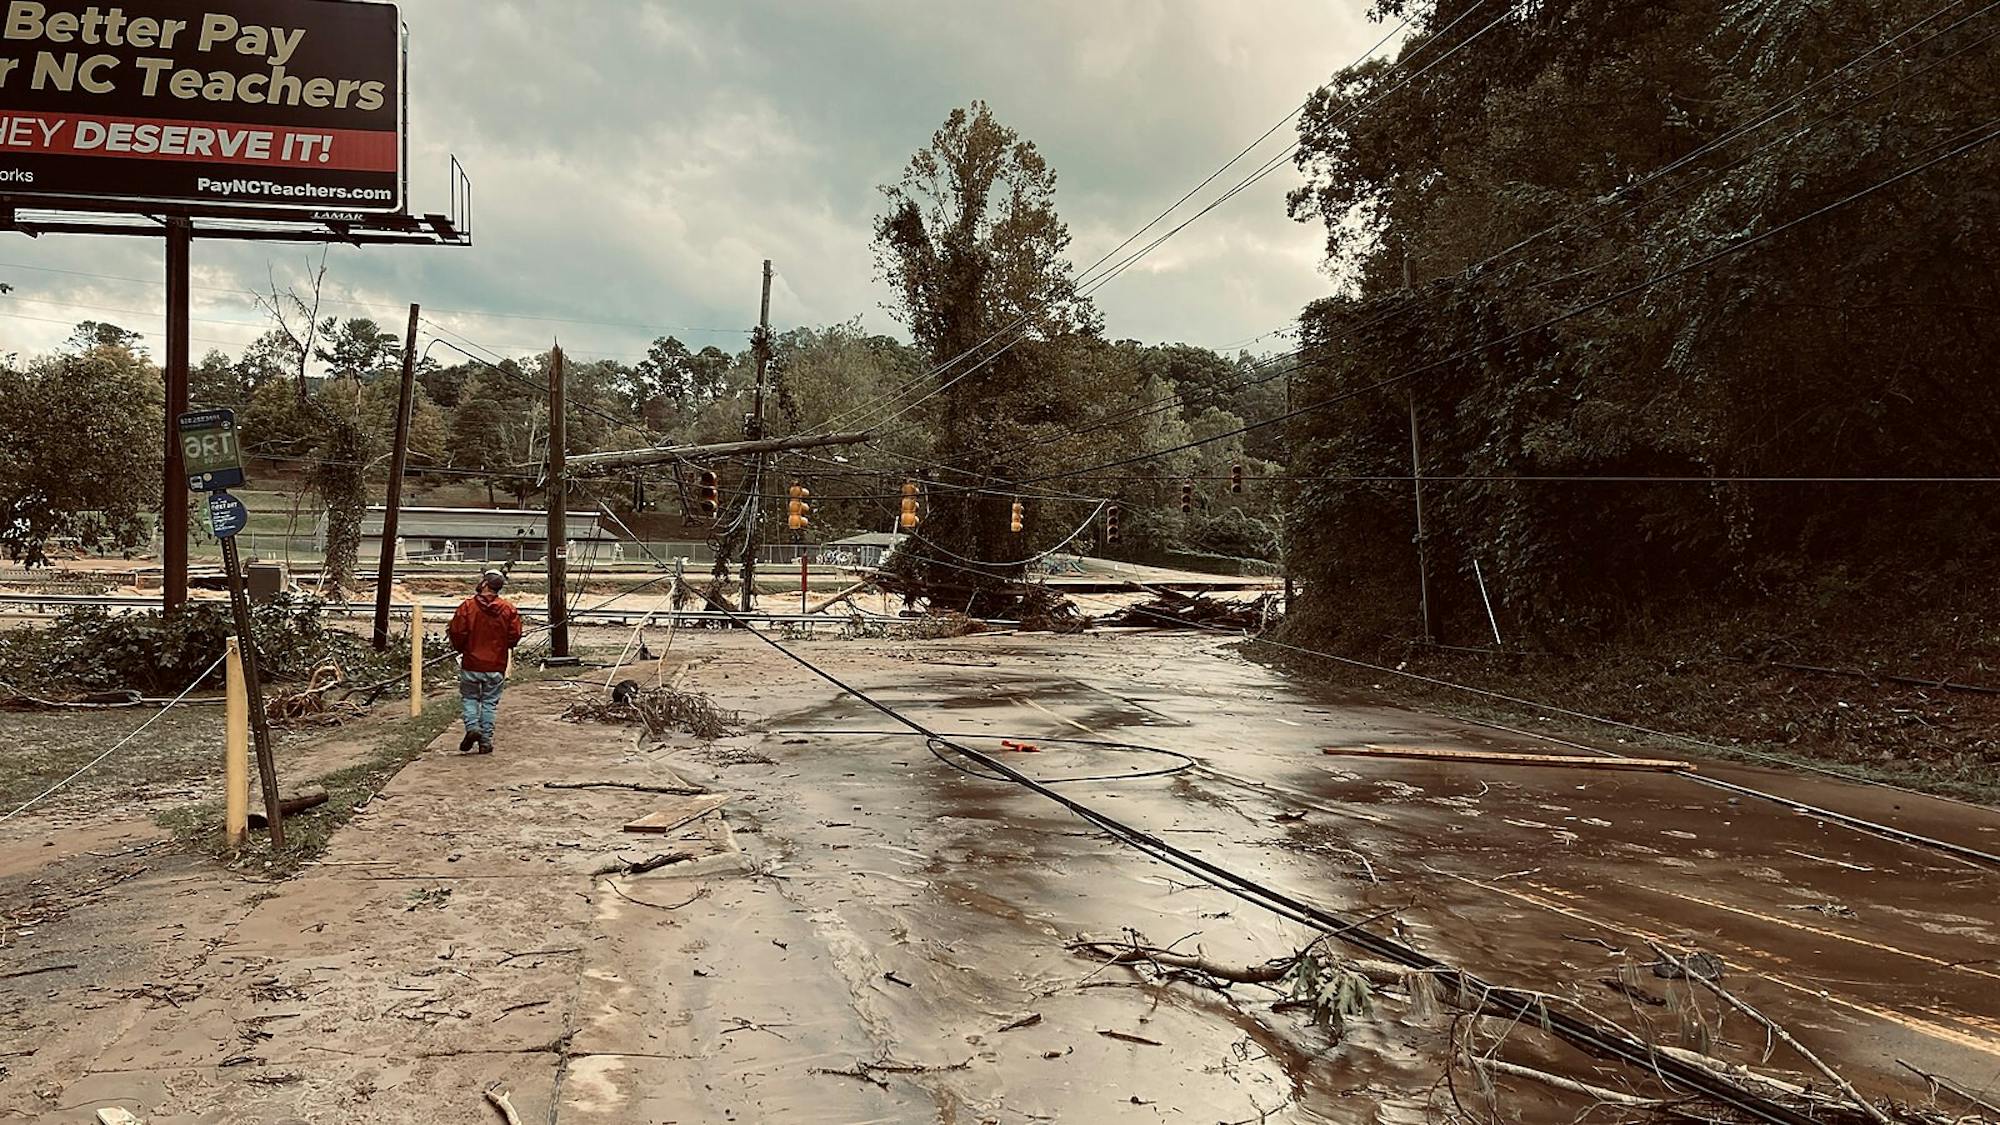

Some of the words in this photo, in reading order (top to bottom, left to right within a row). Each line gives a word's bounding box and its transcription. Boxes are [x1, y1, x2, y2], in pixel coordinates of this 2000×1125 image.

[3, 0, 187, 49] Better
[198, 13, 306, 65] Pay
[31, 51, 120, 94] NC
[135, 57, 386, 110] Teachers
[0, 117, 66, 148] EY
[73, 120, 274, 160] DESERVE
[281, 133, 333, 163] IT!
[198, 178, 392, 200] PayNCTeachers.com
[311, 211, 366, 222] LAMAR
